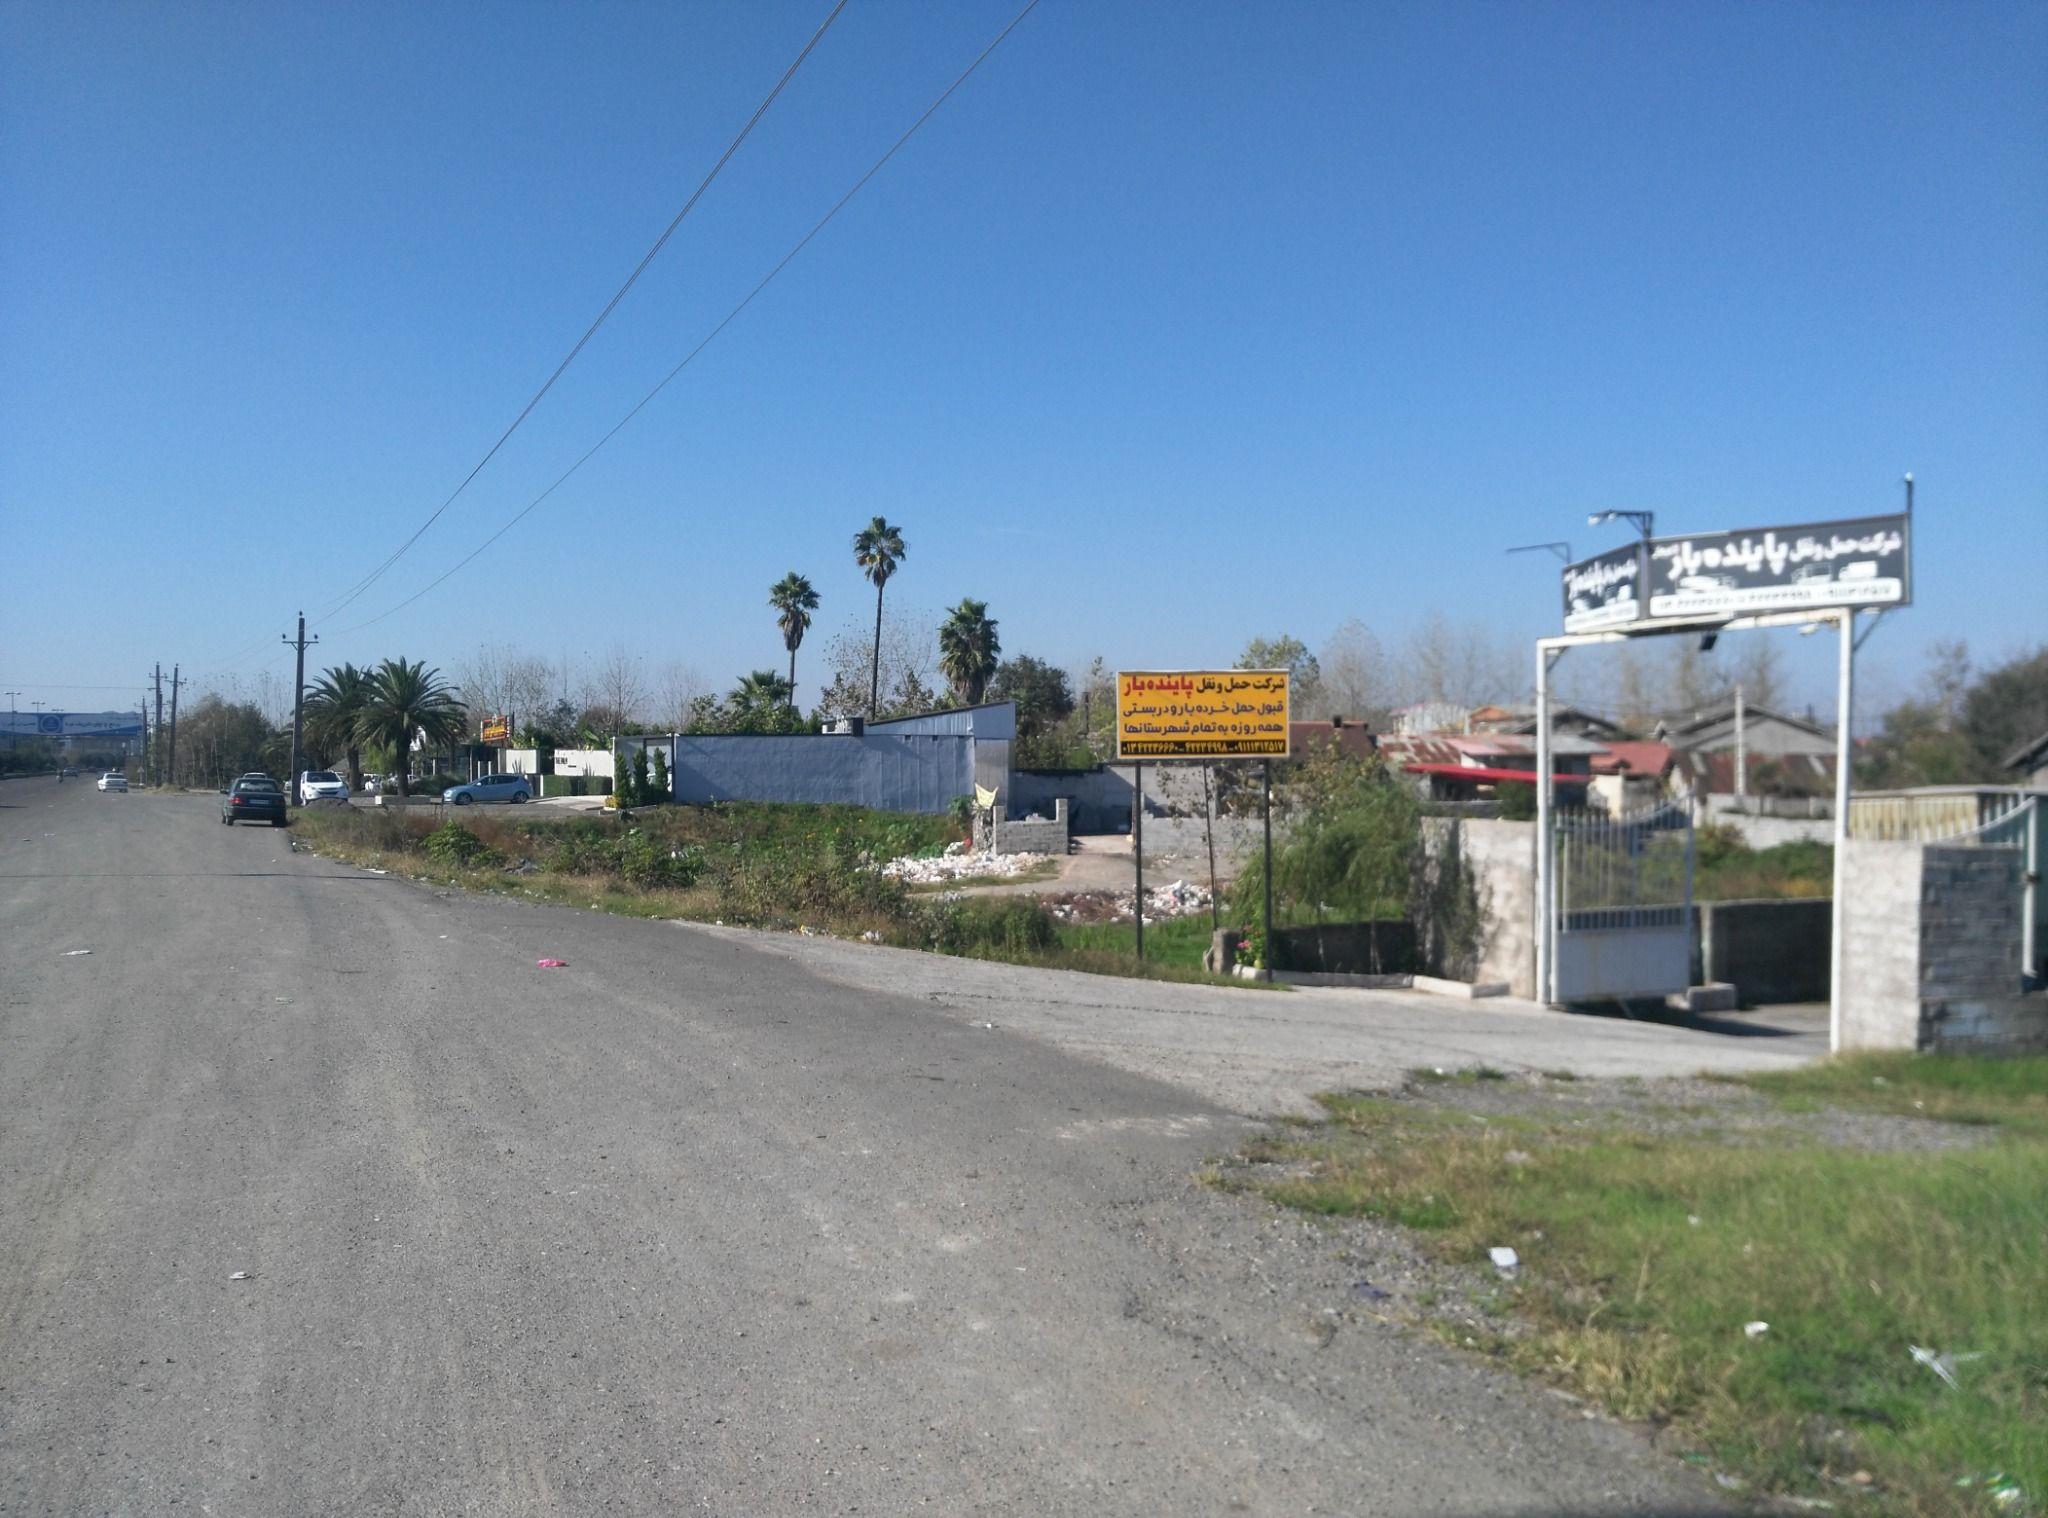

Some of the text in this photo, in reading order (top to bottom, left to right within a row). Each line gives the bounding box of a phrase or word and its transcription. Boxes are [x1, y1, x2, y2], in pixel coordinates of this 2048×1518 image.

[1703, 532, 1788, 576] پاینده
[1123, 675, 1145, 696] بار
[1147, 675, 1194, 698] پاینده
[1224, 677, 1250, 693] حمل
[1252, 677, 1285, 693] شرکت
[1196, 701, 1229, 716] خرده
[1231, 701, 1255, 715] حمل
[1257, 700, 1284, 715] قبول
[1124, 720, 1284, 736] همه روزه به تمام شهرستانها
